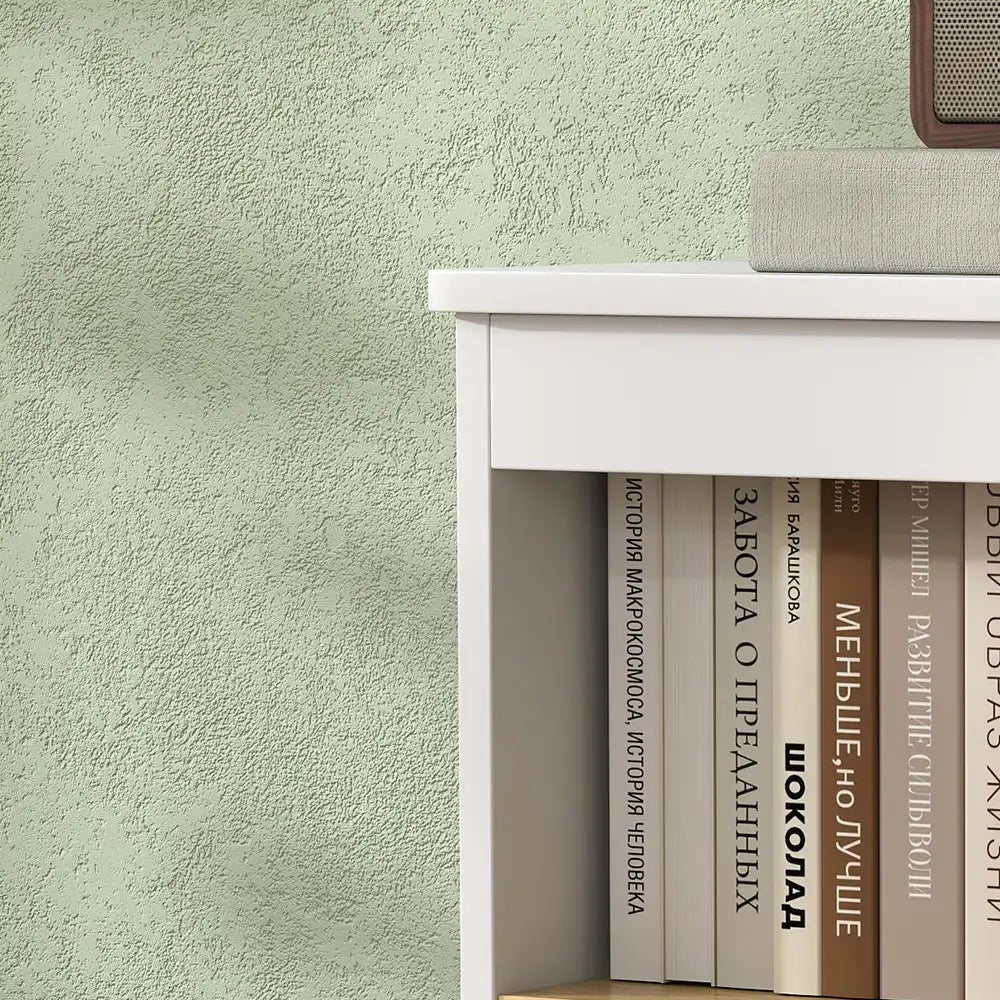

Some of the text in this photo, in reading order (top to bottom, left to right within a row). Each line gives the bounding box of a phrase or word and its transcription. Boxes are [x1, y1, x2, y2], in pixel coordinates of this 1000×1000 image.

[787, 514, 801, 624] БАРАШКОВА
[910, 515, 930, 597] МИШЕЛ
[624, 480, 645, 915] ИСТОРИЯ МАКРОКОСМОСА, ИСТОРИЯ ЧЕЛОВЕКА
[729, 488, 759, 914] ЗАБОТА О ПРЕДАННЫХ
[907, 614, 932, 748] РАЗВИТИЕ
[780, 742, 806, 930] ШОКОЛАД
[835, 815, 862, 938] ЛУЧШЕ
